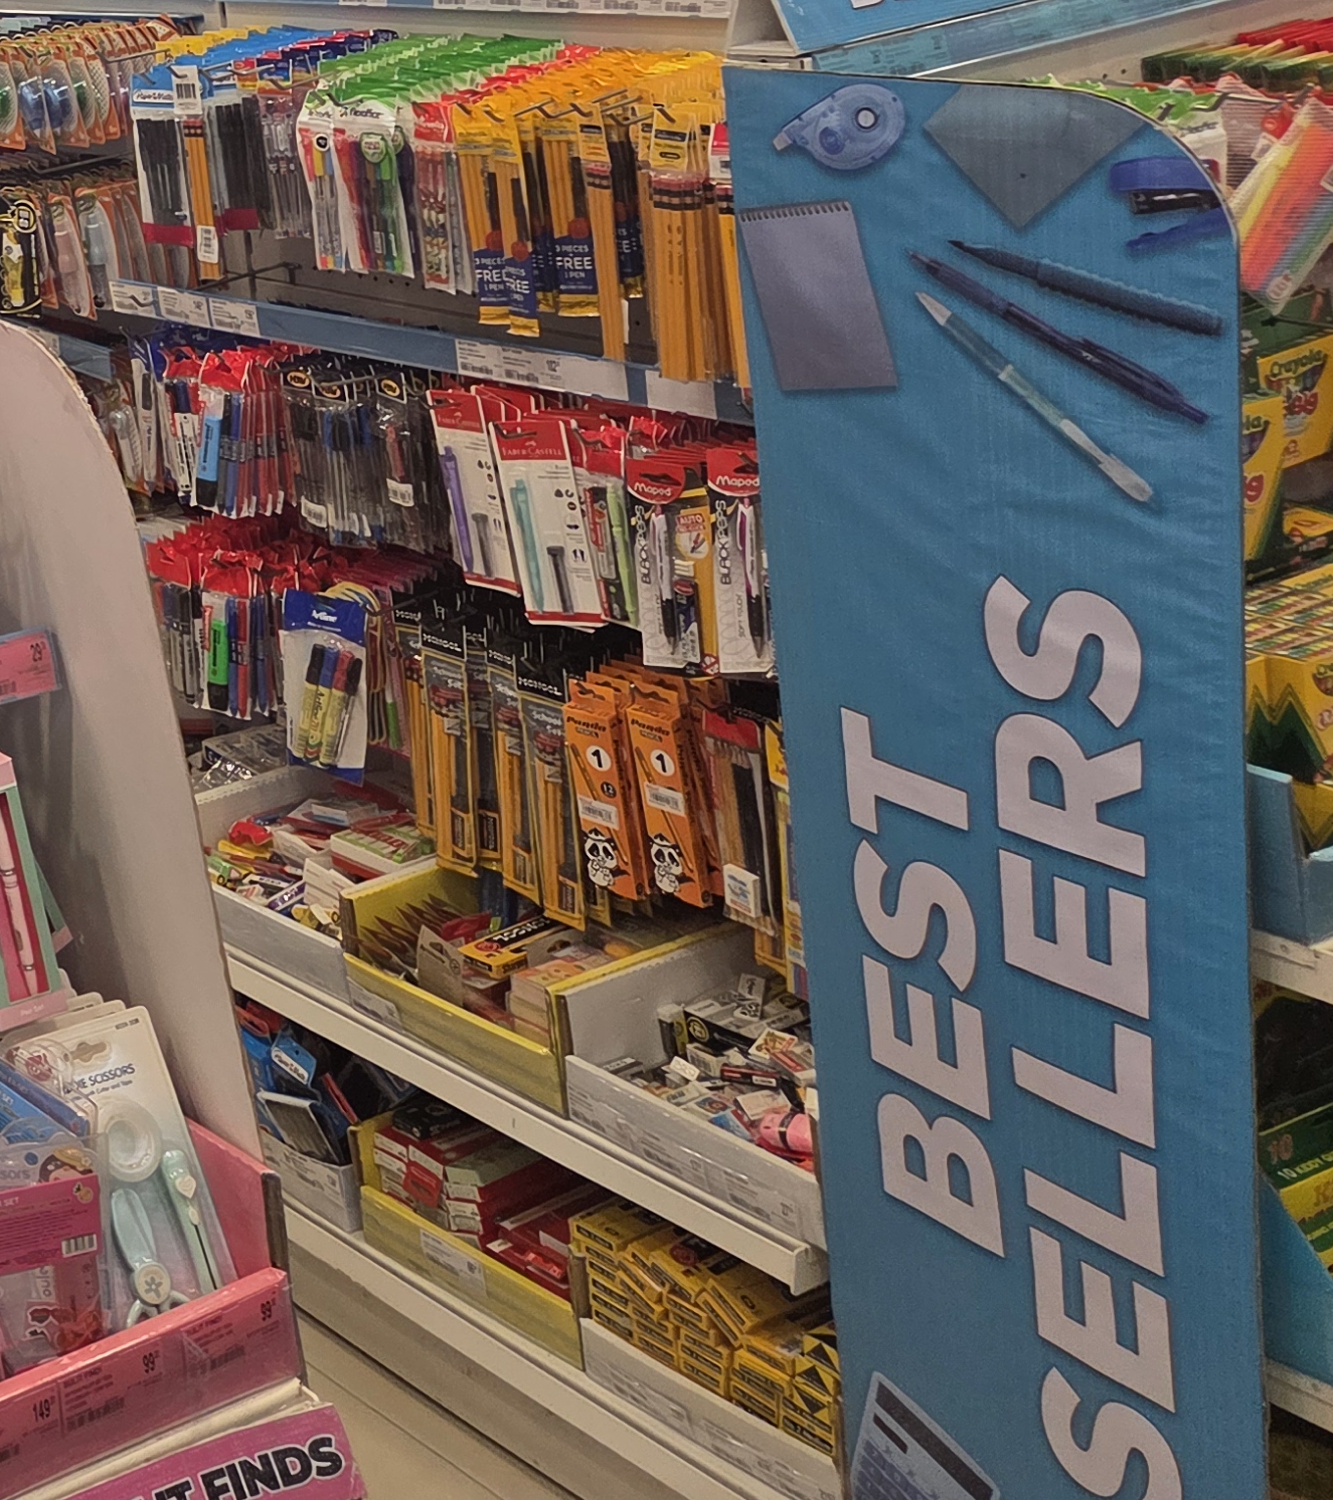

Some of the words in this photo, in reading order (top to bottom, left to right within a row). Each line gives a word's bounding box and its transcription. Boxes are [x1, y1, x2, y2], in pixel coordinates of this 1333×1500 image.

[556, 256, 592, 269] FREE
[1271, 351, 1325, 378] Crayola
[634, 482, 671, 497] Maped
[716, 475, 760, 489] Maped
[591, 749, 605, 770] 1
[655, 753, 669, 773] 1
[840, 705, 1006, 1259] BEST
[983, 572, 1184, 1500] SELLERS
[88, 1063, 136, 1088] SCISSORS
[199, 1434, 345, 1500] FINDS
